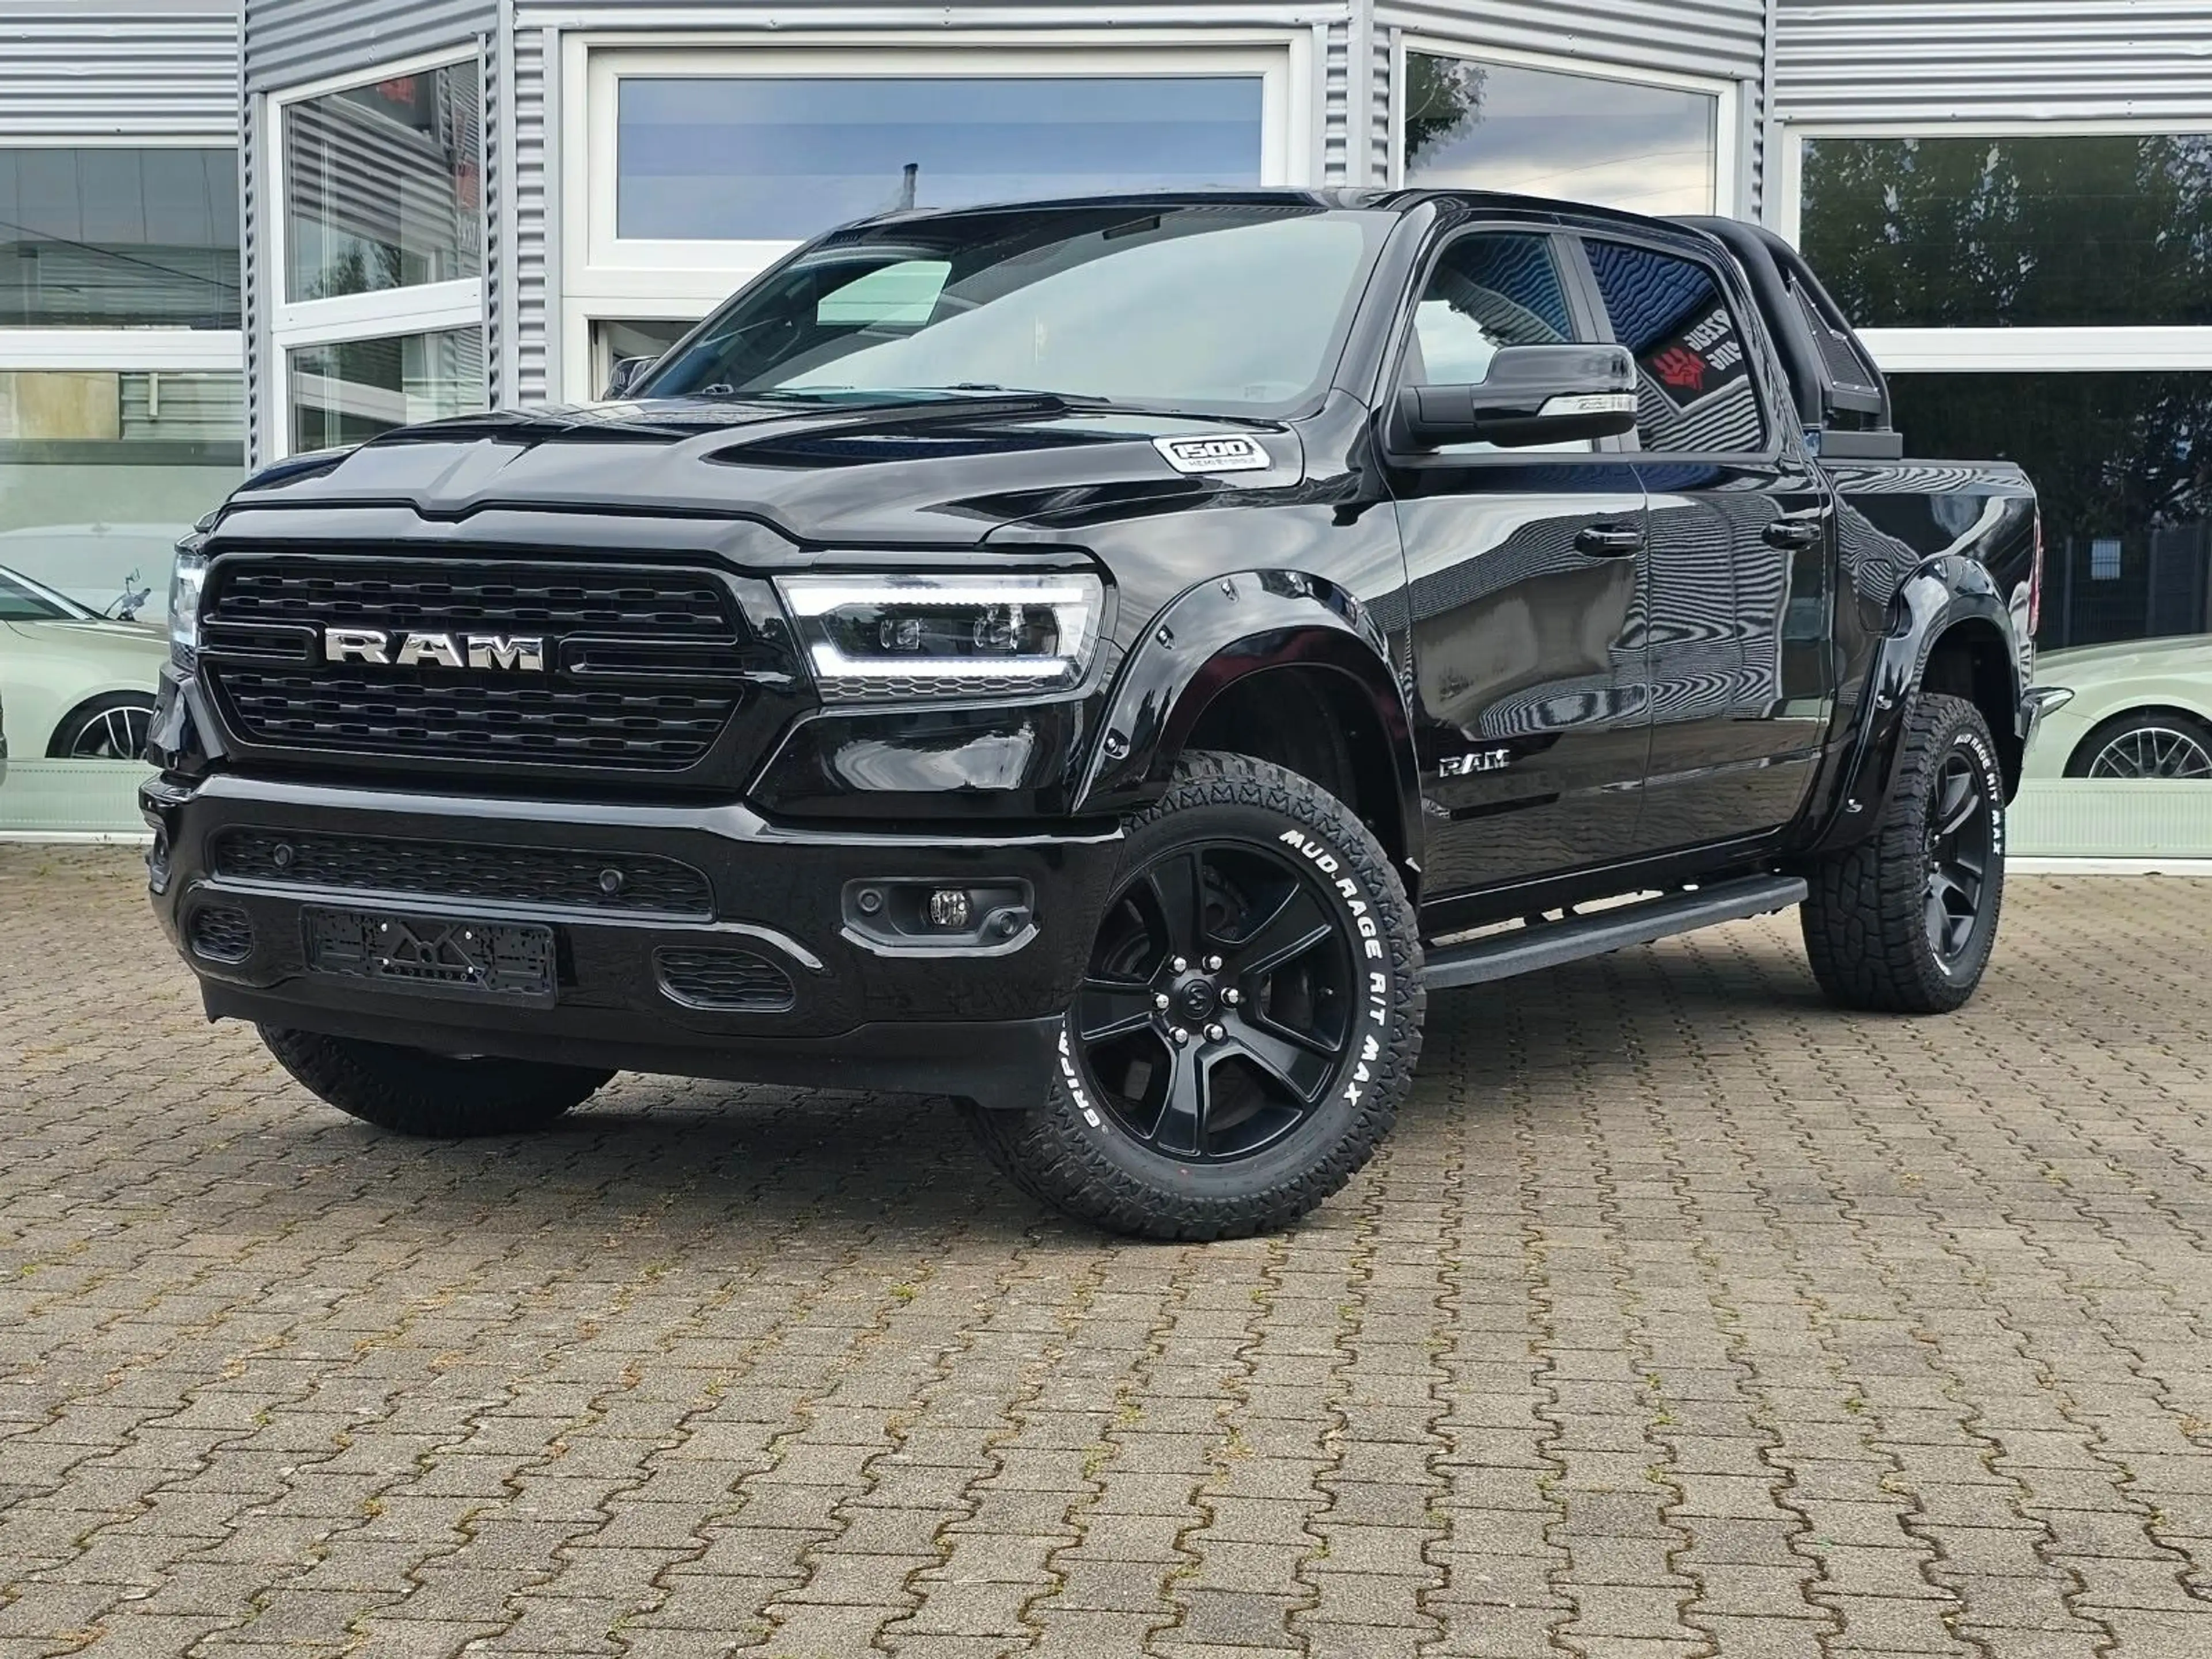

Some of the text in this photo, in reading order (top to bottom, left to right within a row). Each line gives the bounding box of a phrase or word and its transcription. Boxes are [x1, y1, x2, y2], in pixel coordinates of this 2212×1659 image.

[1172, 440, 1249, 459] 1500
[325, 627, 544, 671] RAM
[1439, 749, 1510, 778] RAM
[1991, 809, 2002, 855] MAX
[1279, 829, 1387, 1107] MUD RAGE R/T MAX
